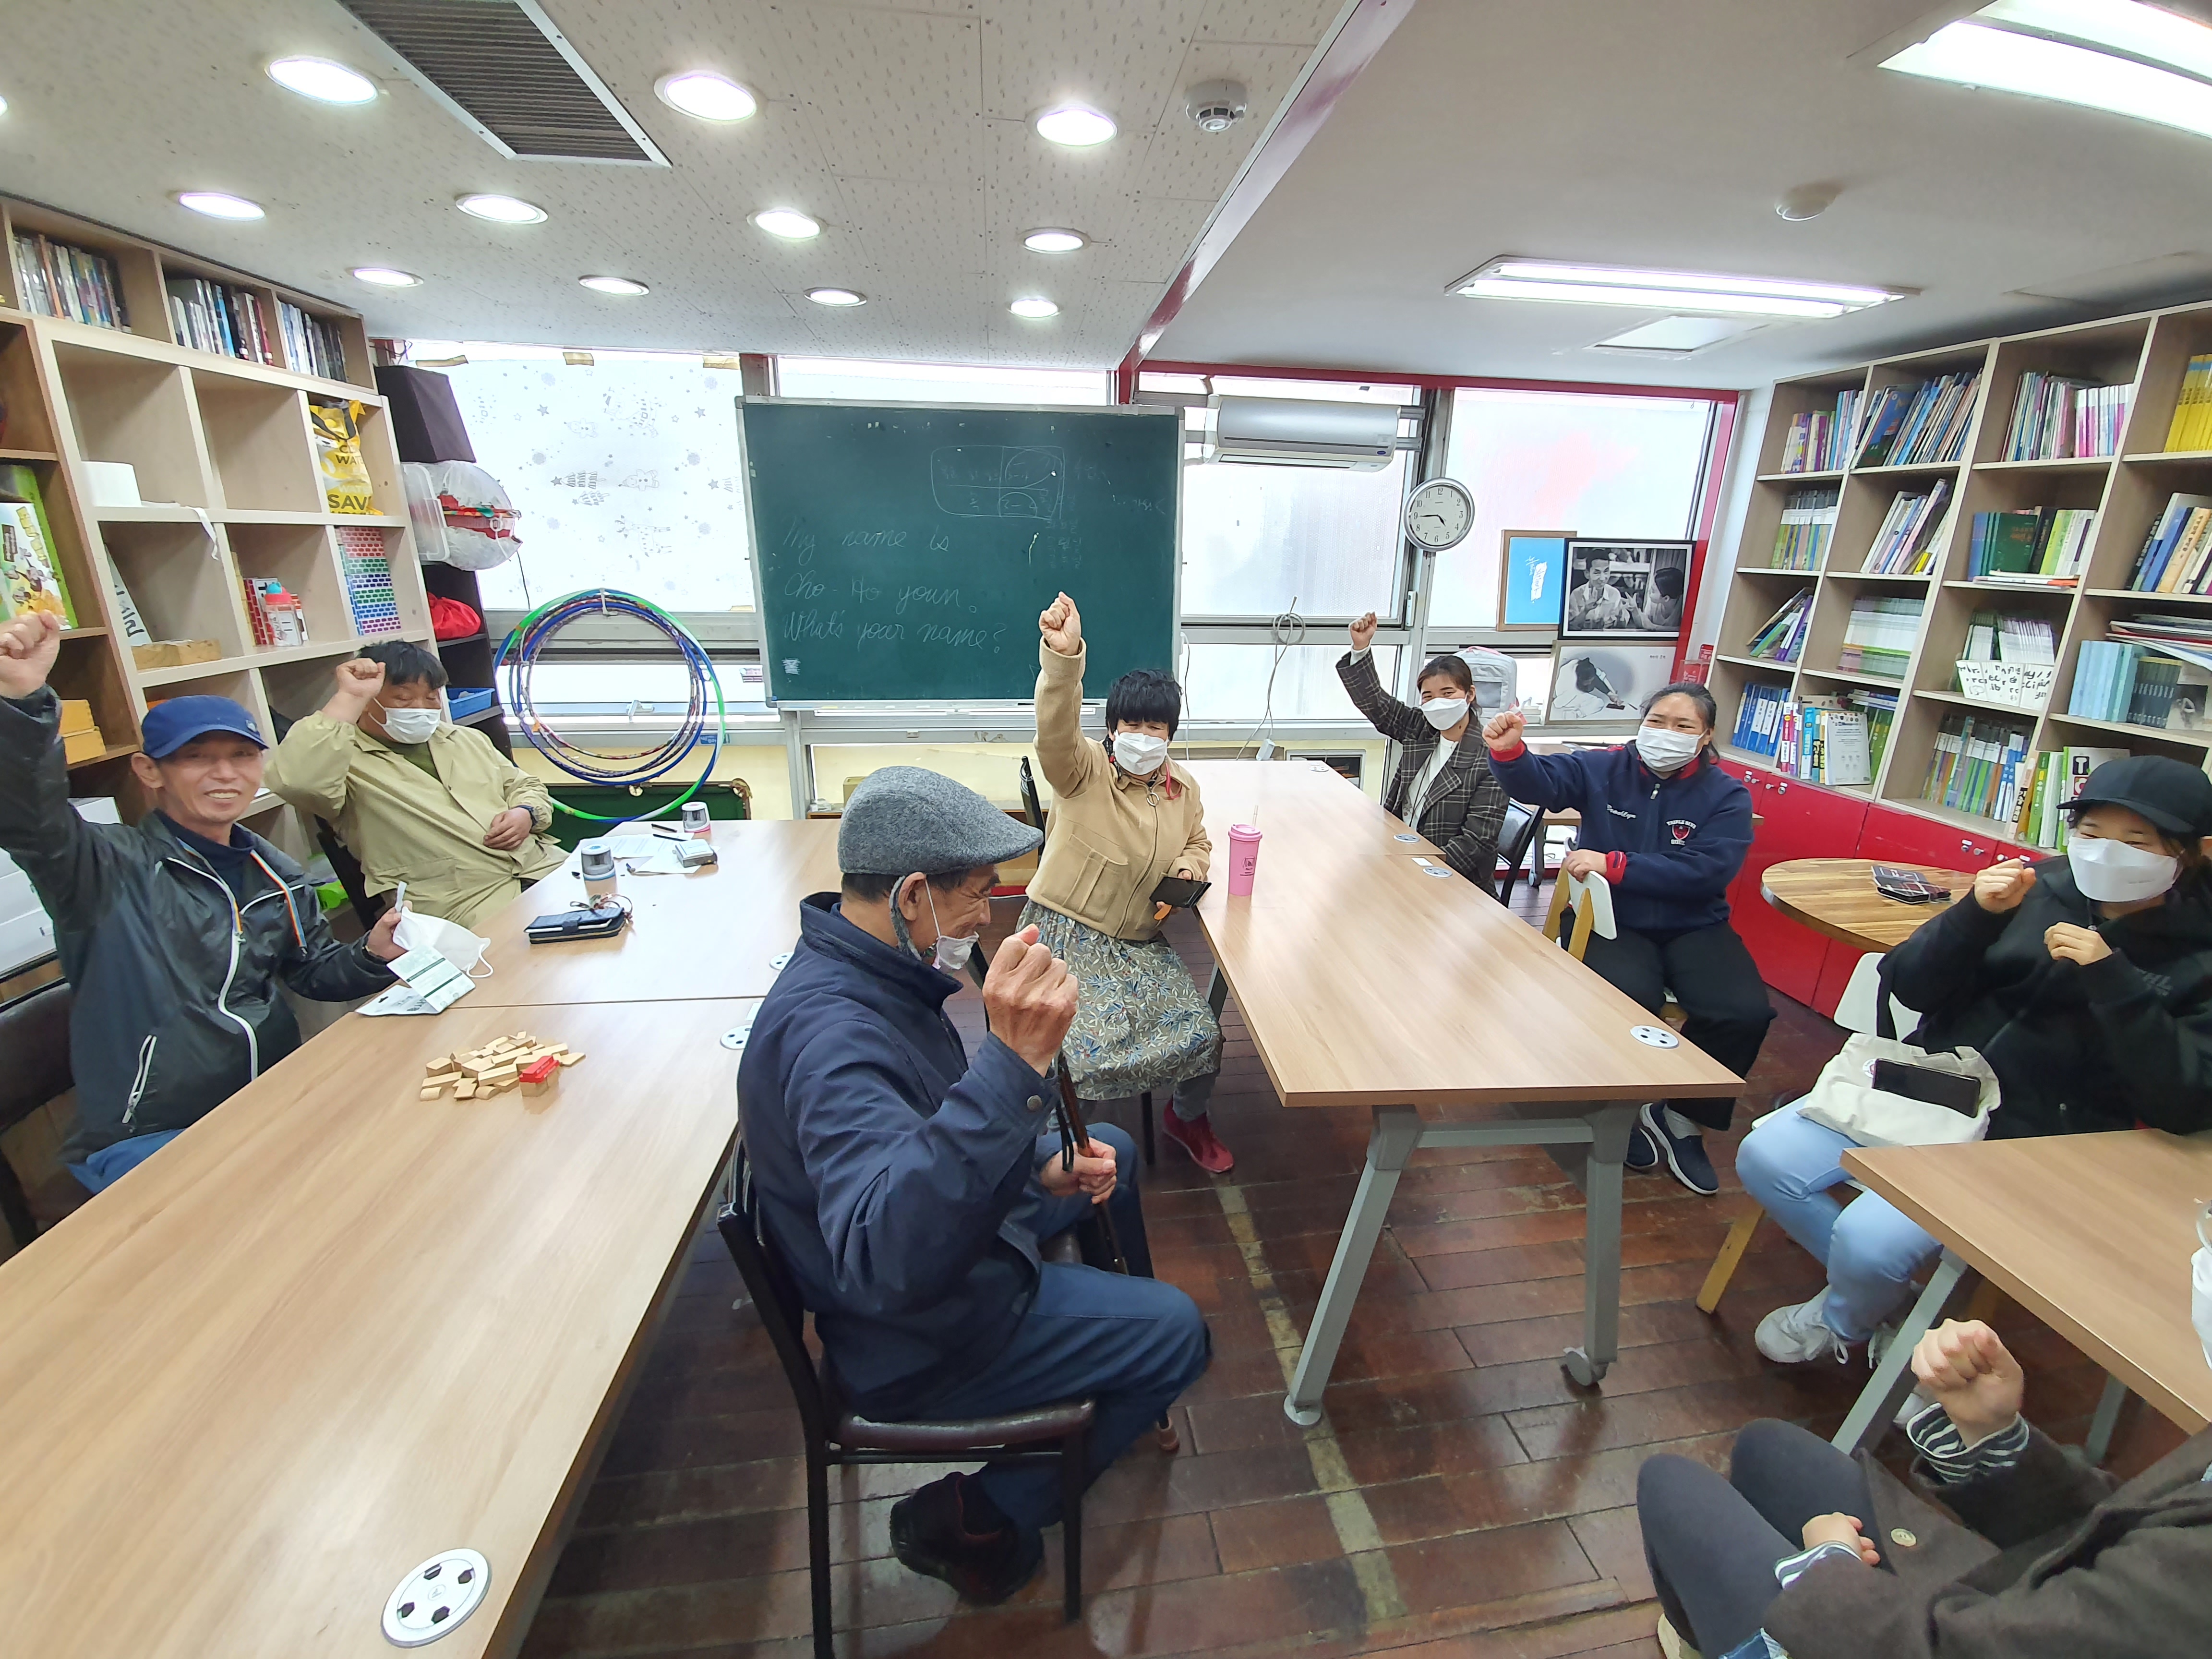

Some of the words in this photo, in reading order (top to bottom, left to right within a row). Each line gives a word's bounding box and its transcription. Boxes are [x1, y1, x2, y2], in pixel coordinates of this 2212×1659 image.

[327, 494, 372, 510] SAV
[1459, 510, 1464, 518] 3
[841, 529, 907, 548] name
[929, 524, 950, 552] is
[1445, 531, 1450, 540] 5
